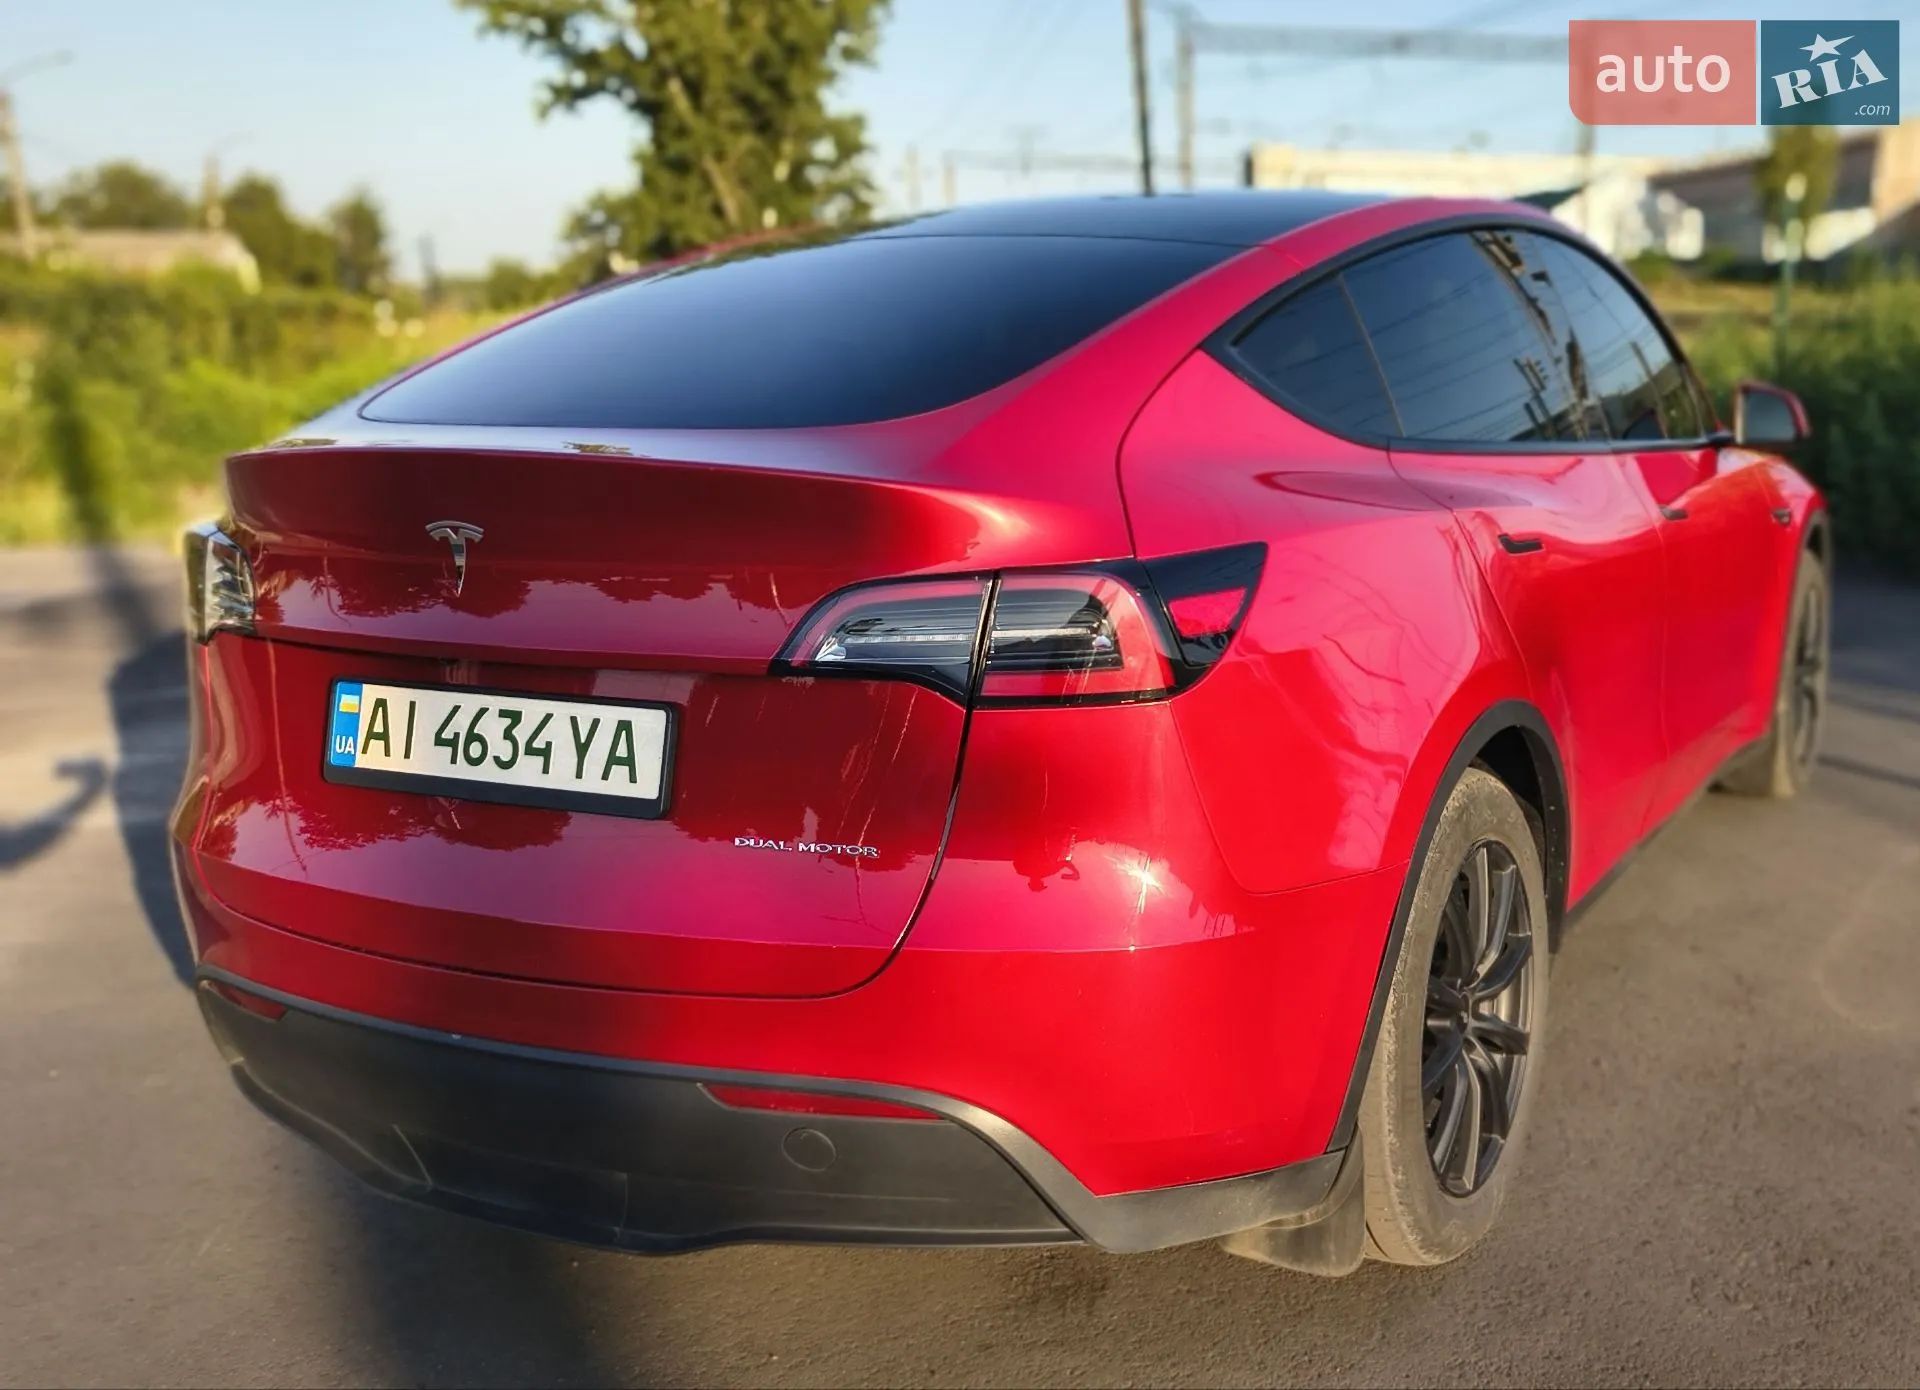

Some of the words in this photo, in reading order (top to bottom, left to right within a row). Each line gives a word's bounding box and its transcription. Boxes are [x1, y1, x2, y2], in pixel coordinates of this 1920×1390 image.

[335, 735, 355, 755] UA
[361, 698, 416, 759] AI
[434, 704, 554, 775] 4634
[570, 715, 638, 784] YA
[734, 837, 792, 852] DUAL
[799, 842, 880, 858] MOTOR
